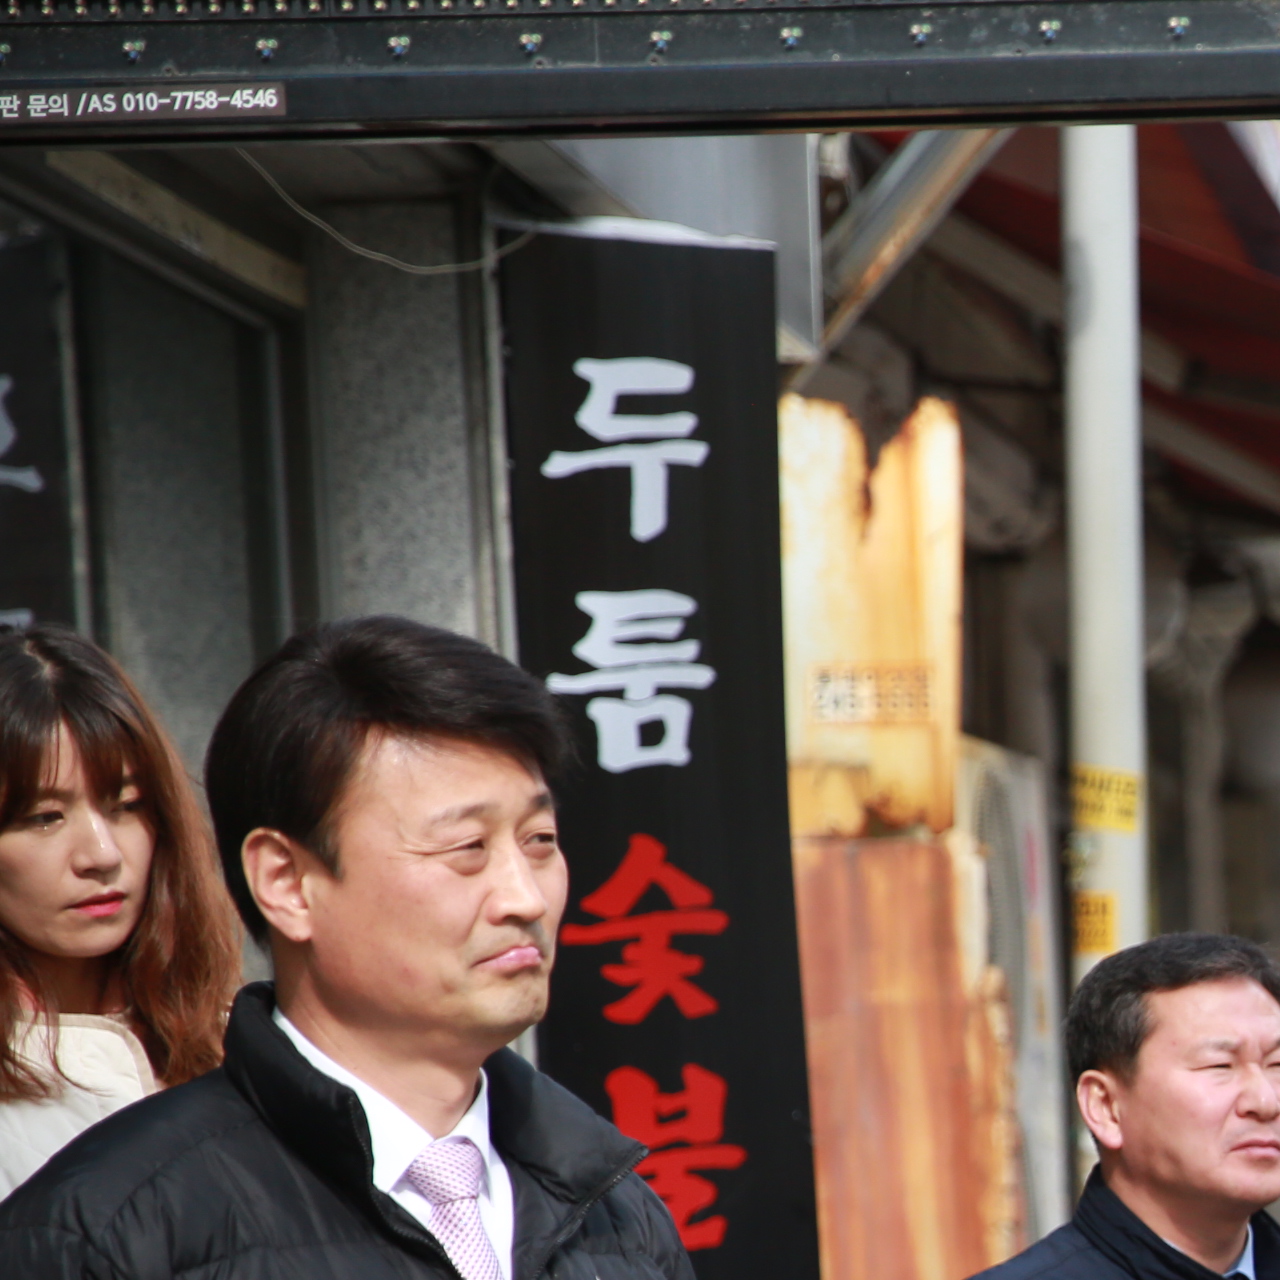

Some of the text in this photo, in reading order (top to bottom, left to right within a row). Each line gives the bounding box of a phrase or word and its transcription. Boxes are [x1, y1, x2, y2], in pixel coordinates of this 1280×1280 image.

[27, 94, 69, 117] 문의
[76, 92, 117, 116] /AS
[122, 88, 278, 113] 010-7758-4546
[540, 356, 717, 774] 두툼
